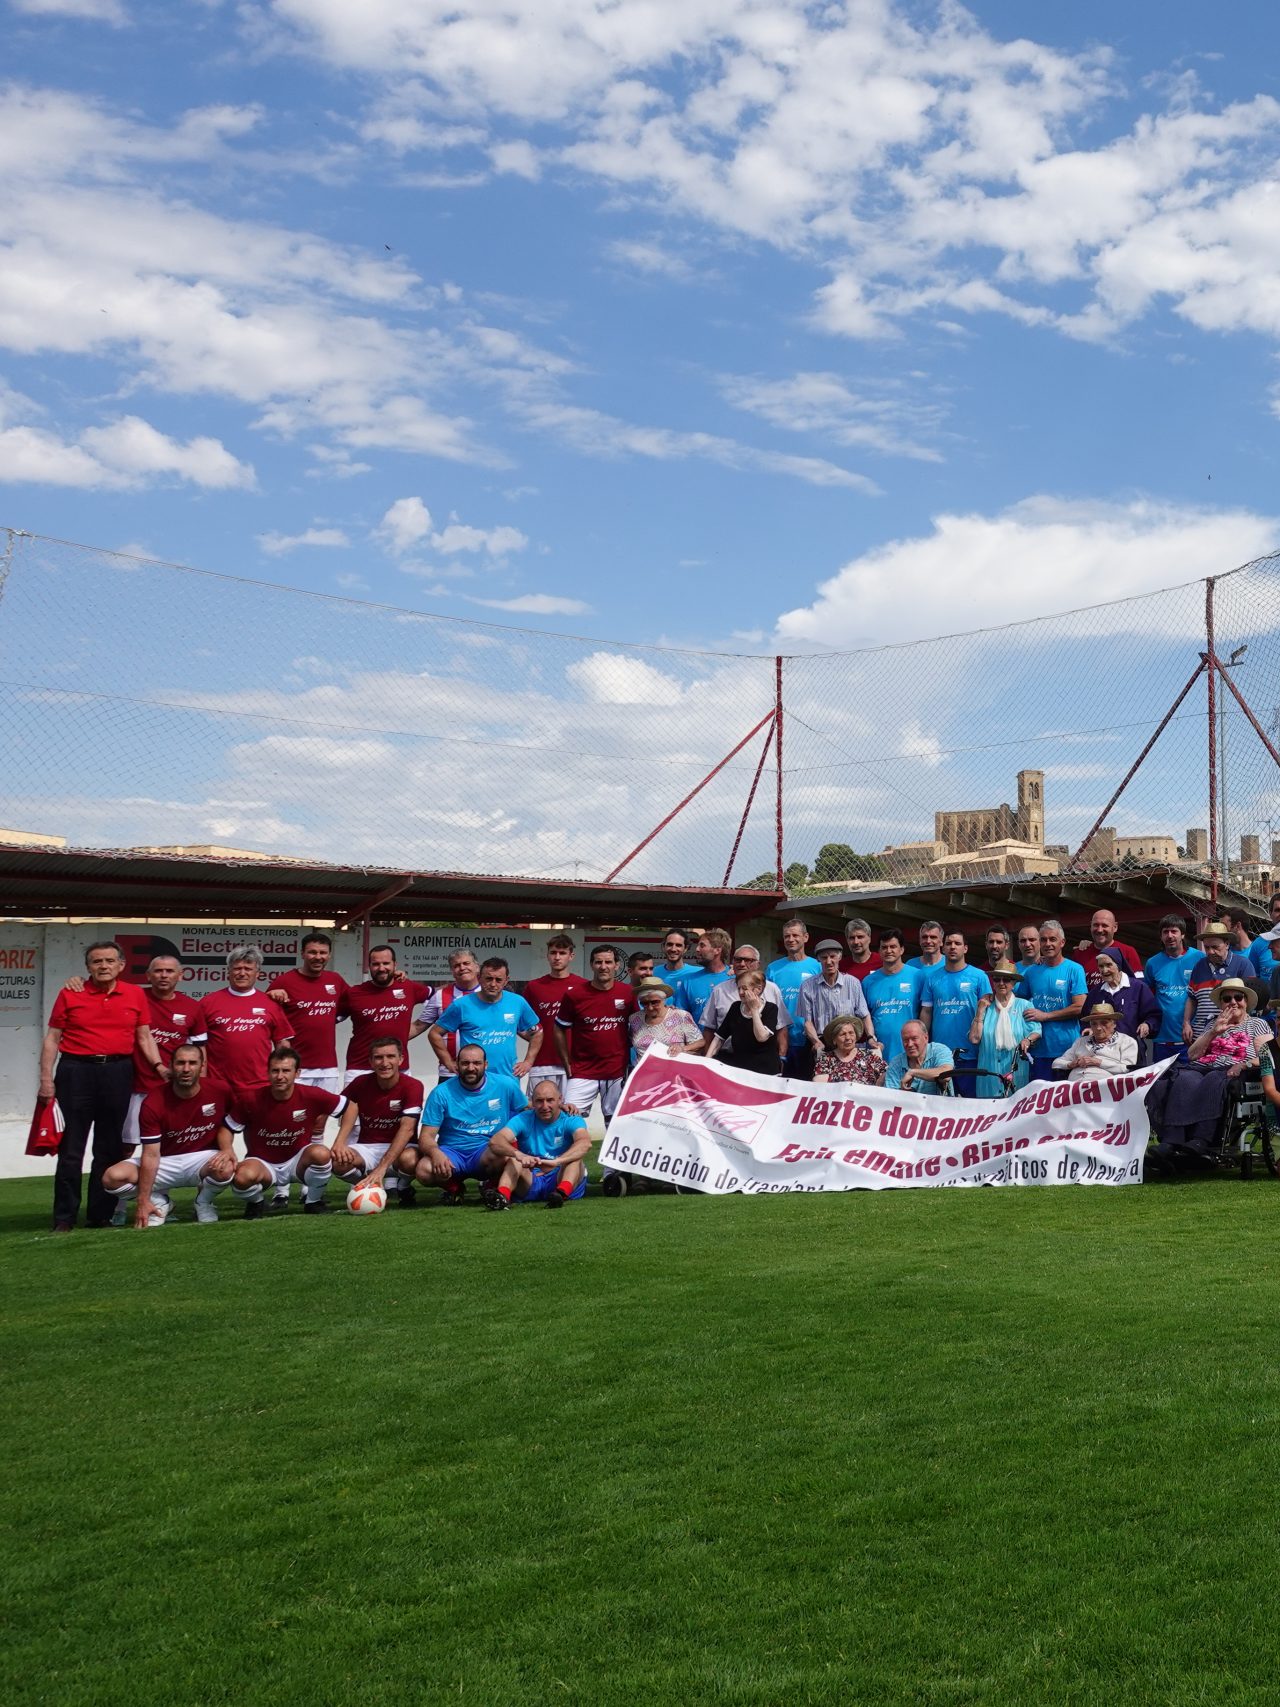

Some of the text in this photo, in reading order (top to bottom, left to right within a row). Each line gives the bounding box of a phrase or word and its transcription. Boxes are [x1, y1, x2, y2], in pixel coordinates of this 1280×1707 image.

[182, 927, 298, 937] MONTAJES ELECTRICOS
[182, 938, 298, 954] Electriidad
[404, 934, 517, 949] CARPINTERÍA CATALÁN
[182, 967, 230, 982] Ofici
[791, 1096, 873, 1132] Hazte
[879, 1106, 998, 1141] donante
[605, 1136, 711, 1183] Asociación
[714, 1169, 739, 1190] de
[1057, 1154, 1080, 1180] de
